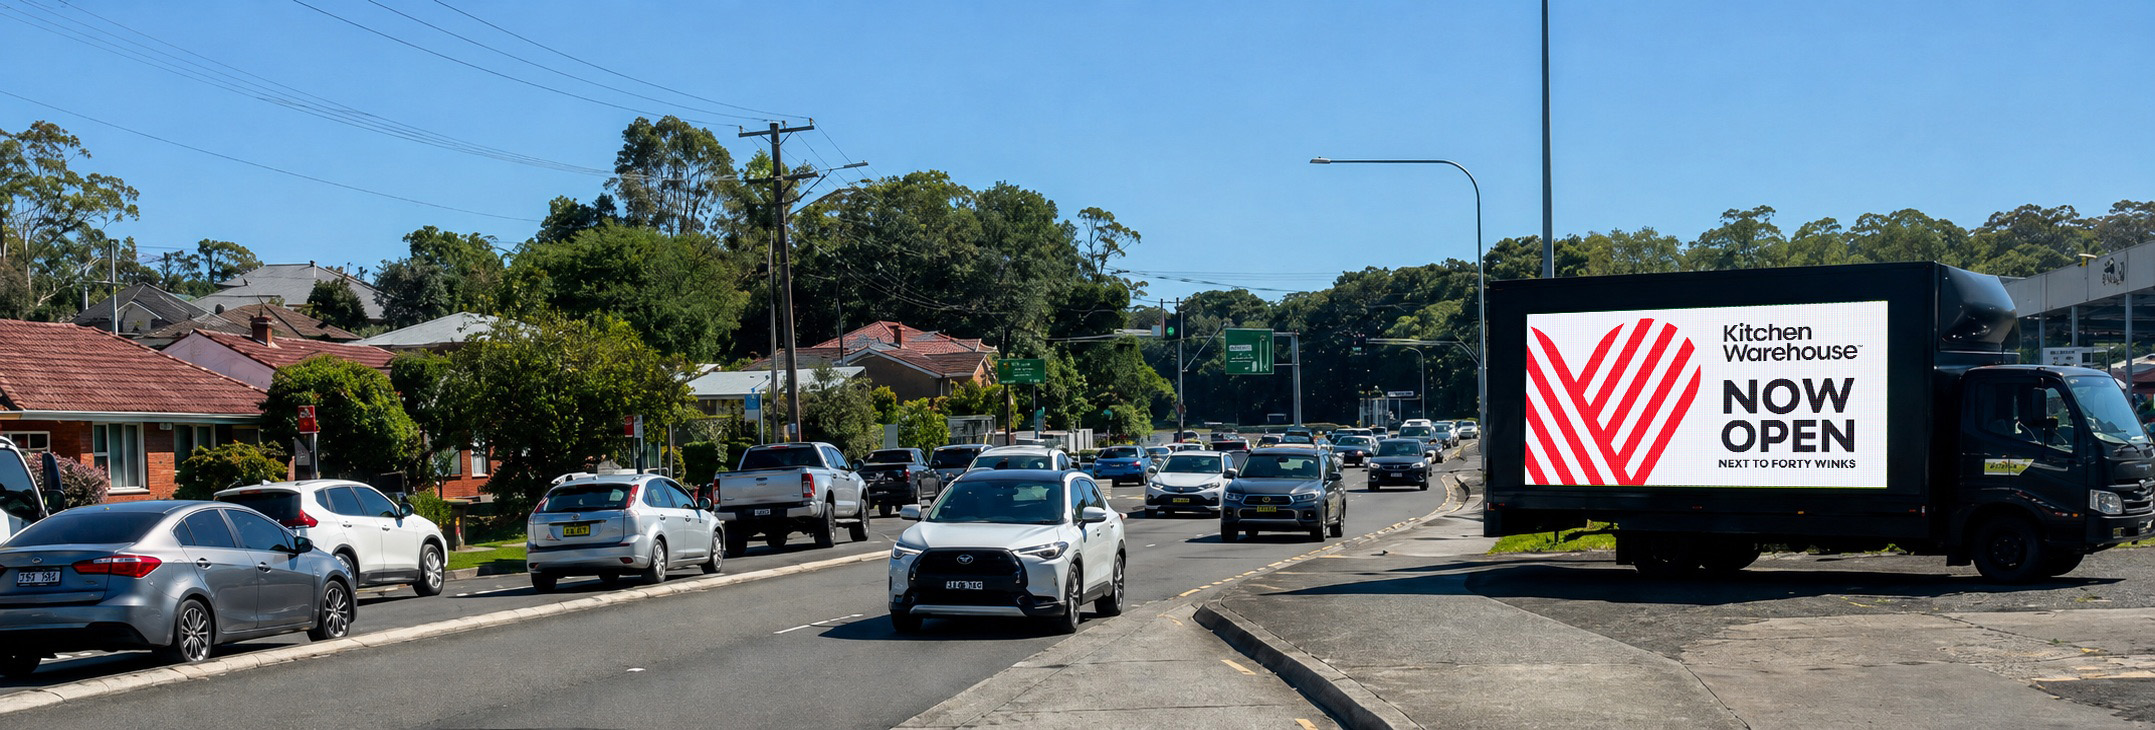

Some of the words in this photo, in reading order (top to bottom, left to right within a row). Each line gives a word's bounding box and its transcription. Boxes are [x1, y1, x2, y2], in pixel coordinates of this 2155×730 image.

[1723, 322, 1812, 342] Kitchen
[1722, 342, 1858, 363] Warehouse
[1723, 377, 1855, 415] NOW
[1721, 419, 1855, 453] OPEN
[1718, 459, 1750, 469] NEXT
[1752, 459, 1769, 469] TO
[1771, 459, 1812, 469] FORTY
[1814, 459, 1857, 469] WINKS
